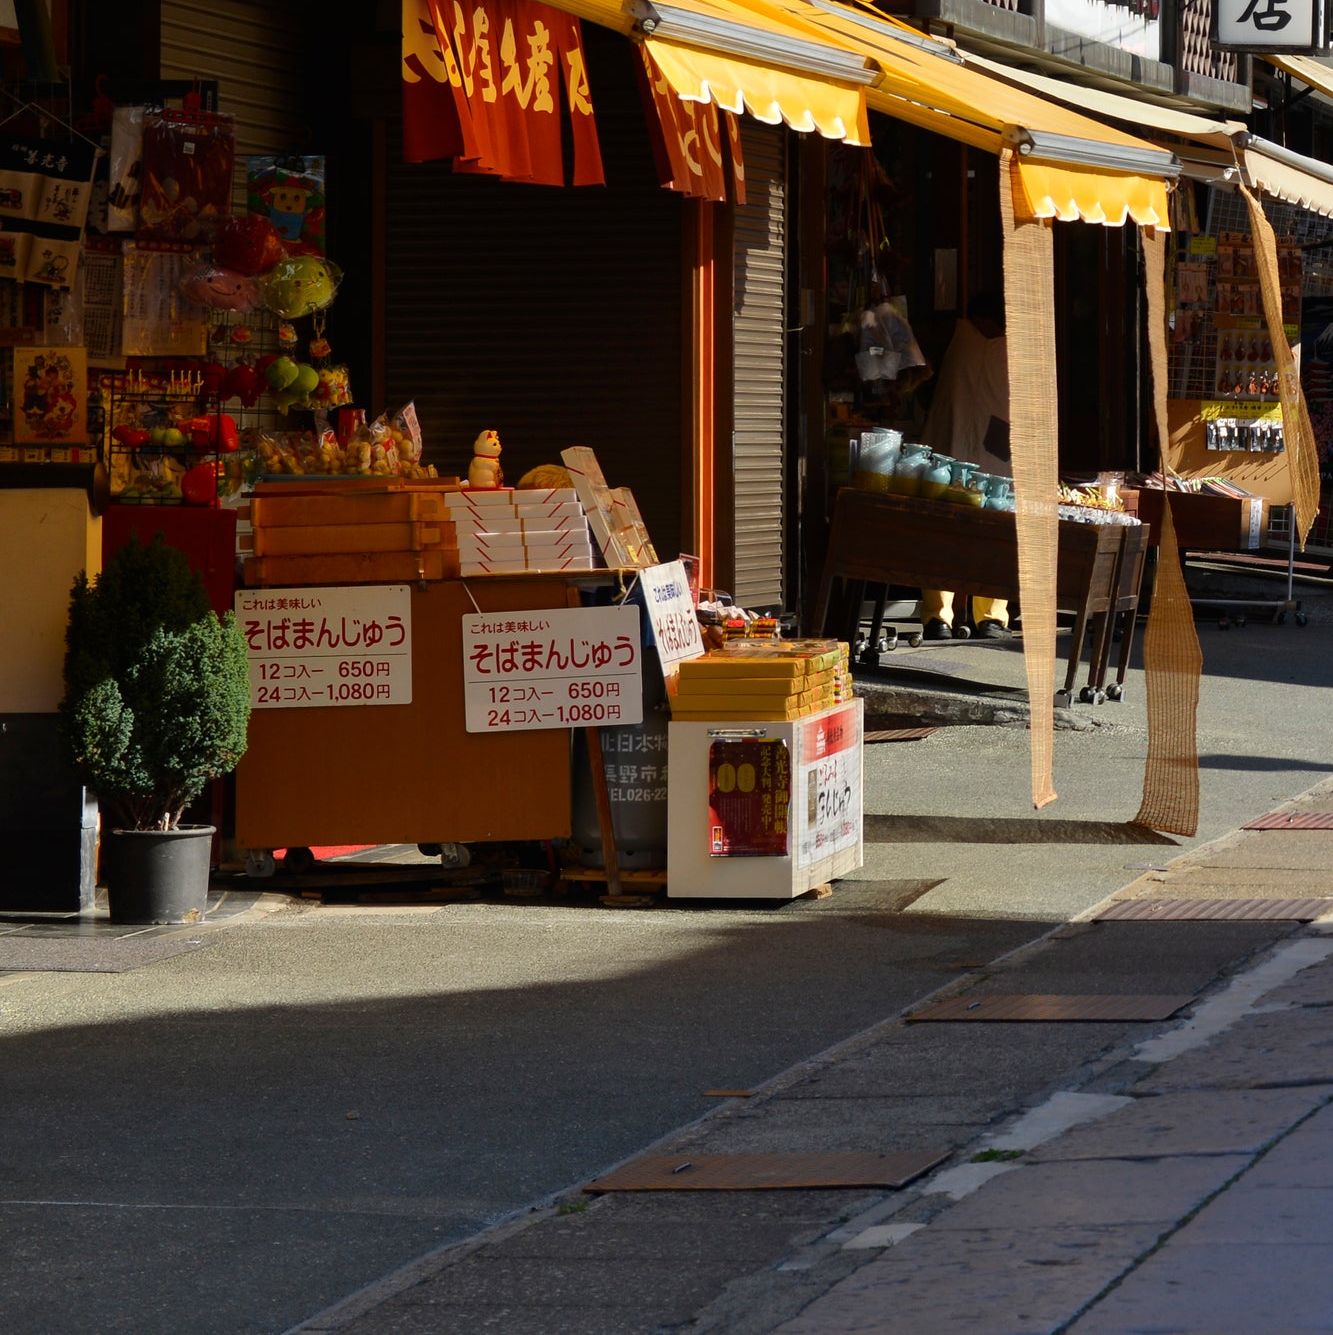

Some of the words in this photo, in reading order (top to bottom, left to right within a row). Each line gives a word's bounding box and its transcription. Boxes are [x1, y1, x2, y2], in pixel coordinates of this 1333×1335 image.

[242, 598, 322, 611] これは美味しい
[244, 615, 407, 651] そばまんじゅう
[470, 619, 550, 634] これは美味しい
[468, 635, 636, 675] そばまんじゅう
[338, 660, 391, 679] 650円
[568, 681, 621, 700] 650円
